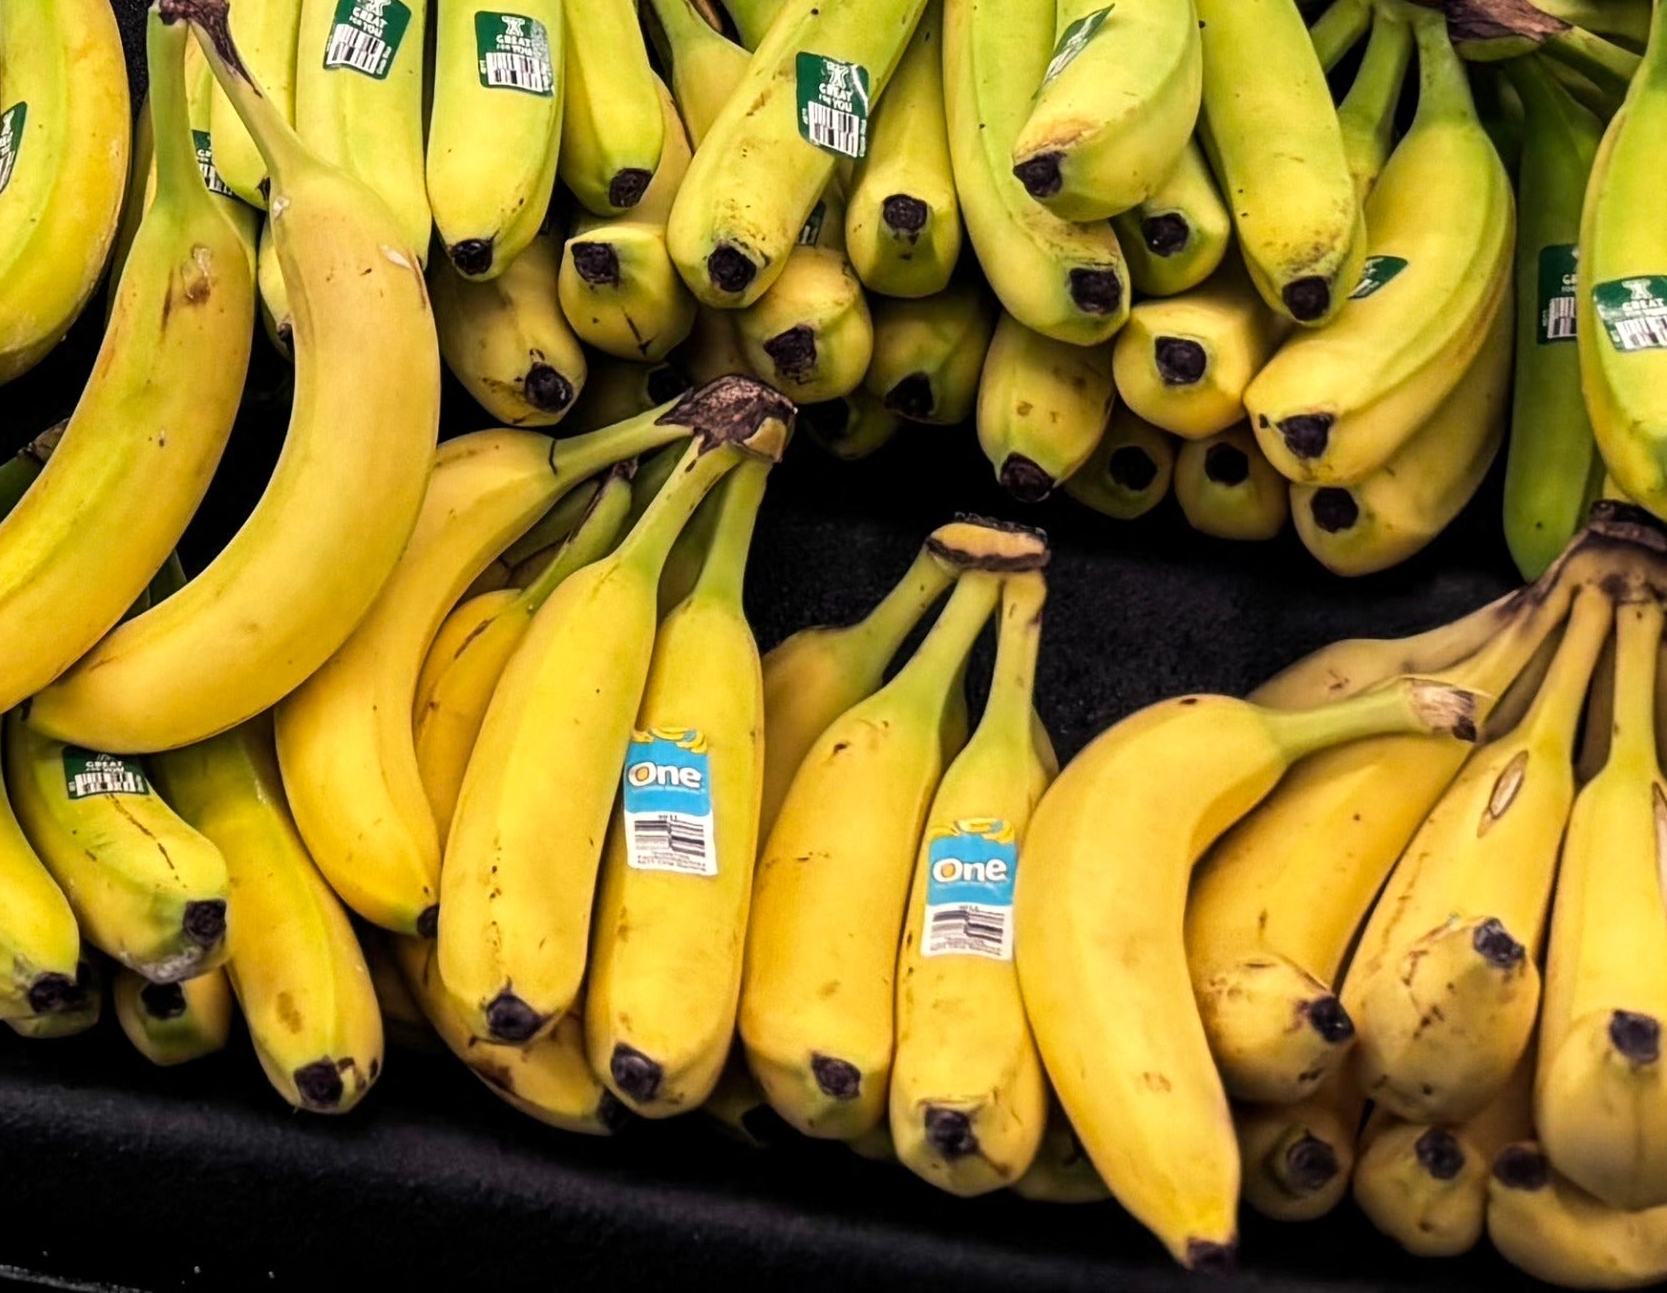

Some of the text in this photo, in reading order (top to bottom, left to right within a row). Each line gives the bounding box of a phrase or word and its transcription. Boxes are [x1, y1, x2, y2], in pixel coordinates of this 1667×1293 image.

[352, 6, 389, 26] GREAT
[363, 23, 383, 37] YOU
[496, 33, 531, 46] GREAT
[819, 83, 853, 101] GREAT
[627, 761, 701, 790] One
[932, 857, 1007, 883] One
